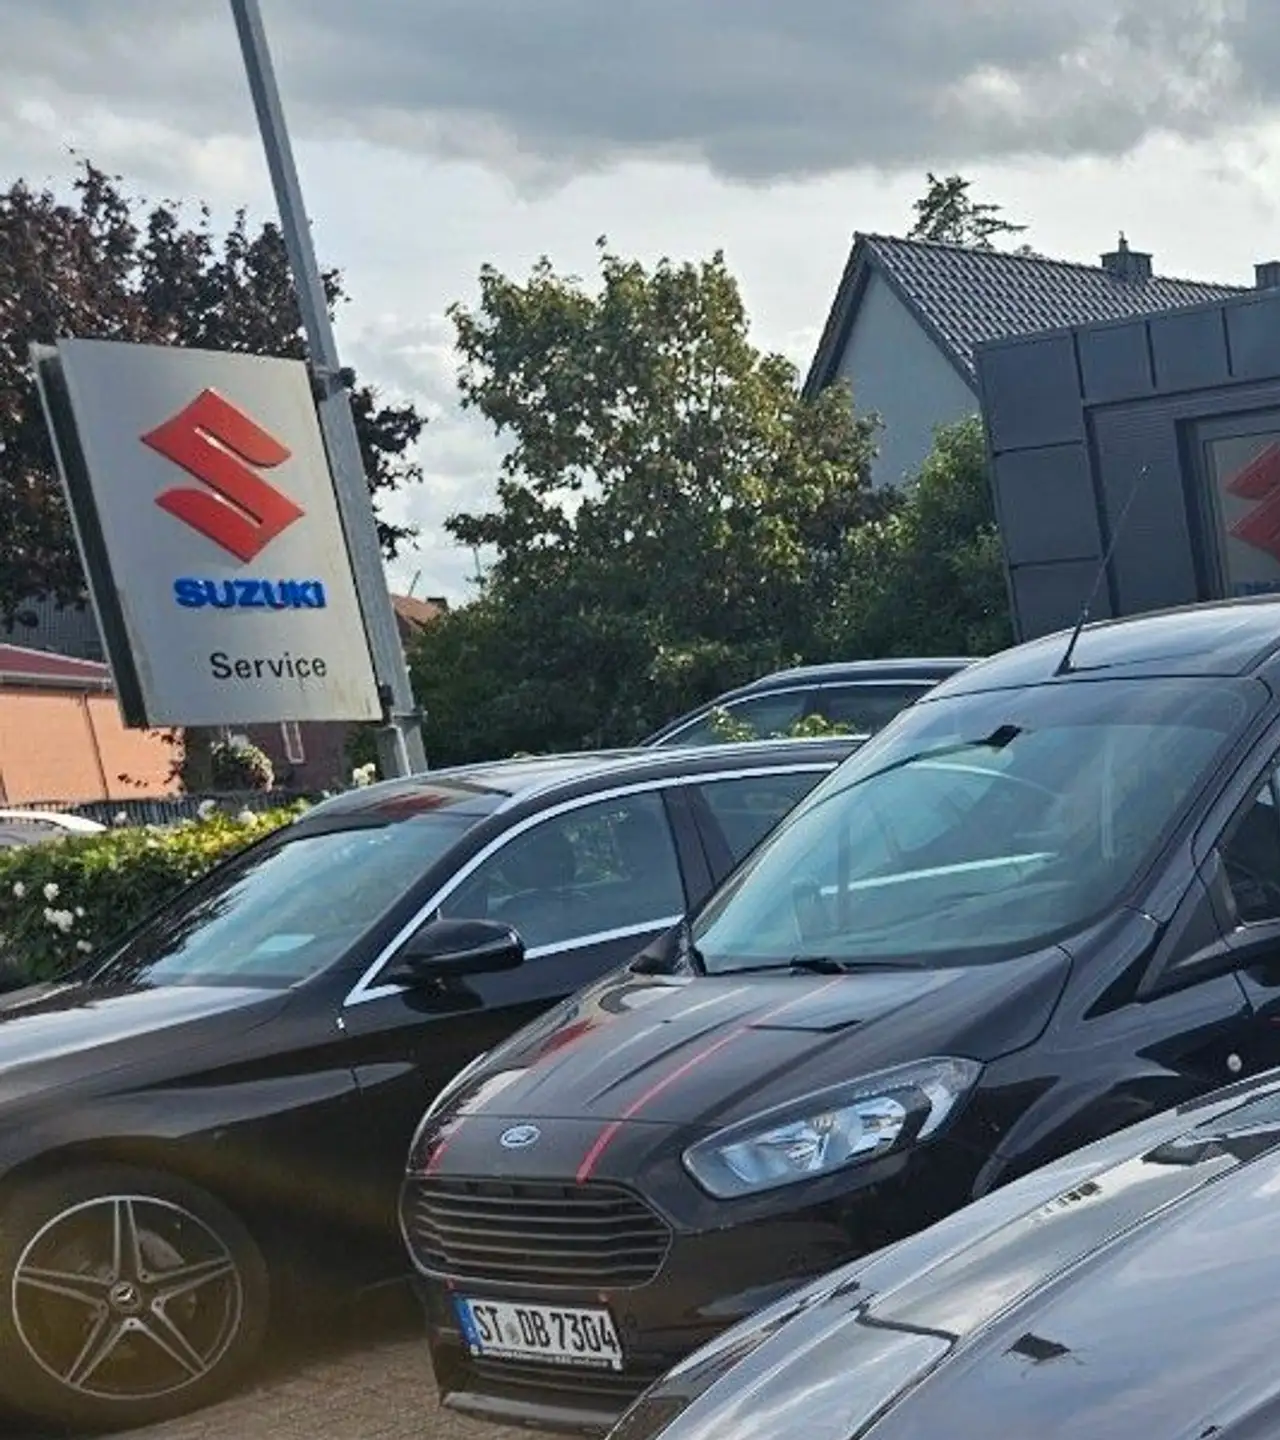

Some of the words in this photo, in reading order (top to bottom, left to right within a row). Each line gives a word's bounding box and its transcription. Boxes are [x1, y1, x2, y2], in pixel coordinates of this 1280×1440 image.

[172, 577, 327, 609] SUZUKI
[209, 651, 327, 680] Service
[472, 1305, 504, 1343] ST
[514, 1307, 552, 1348] DB
[550, 1311, 617, 1353] 7304
